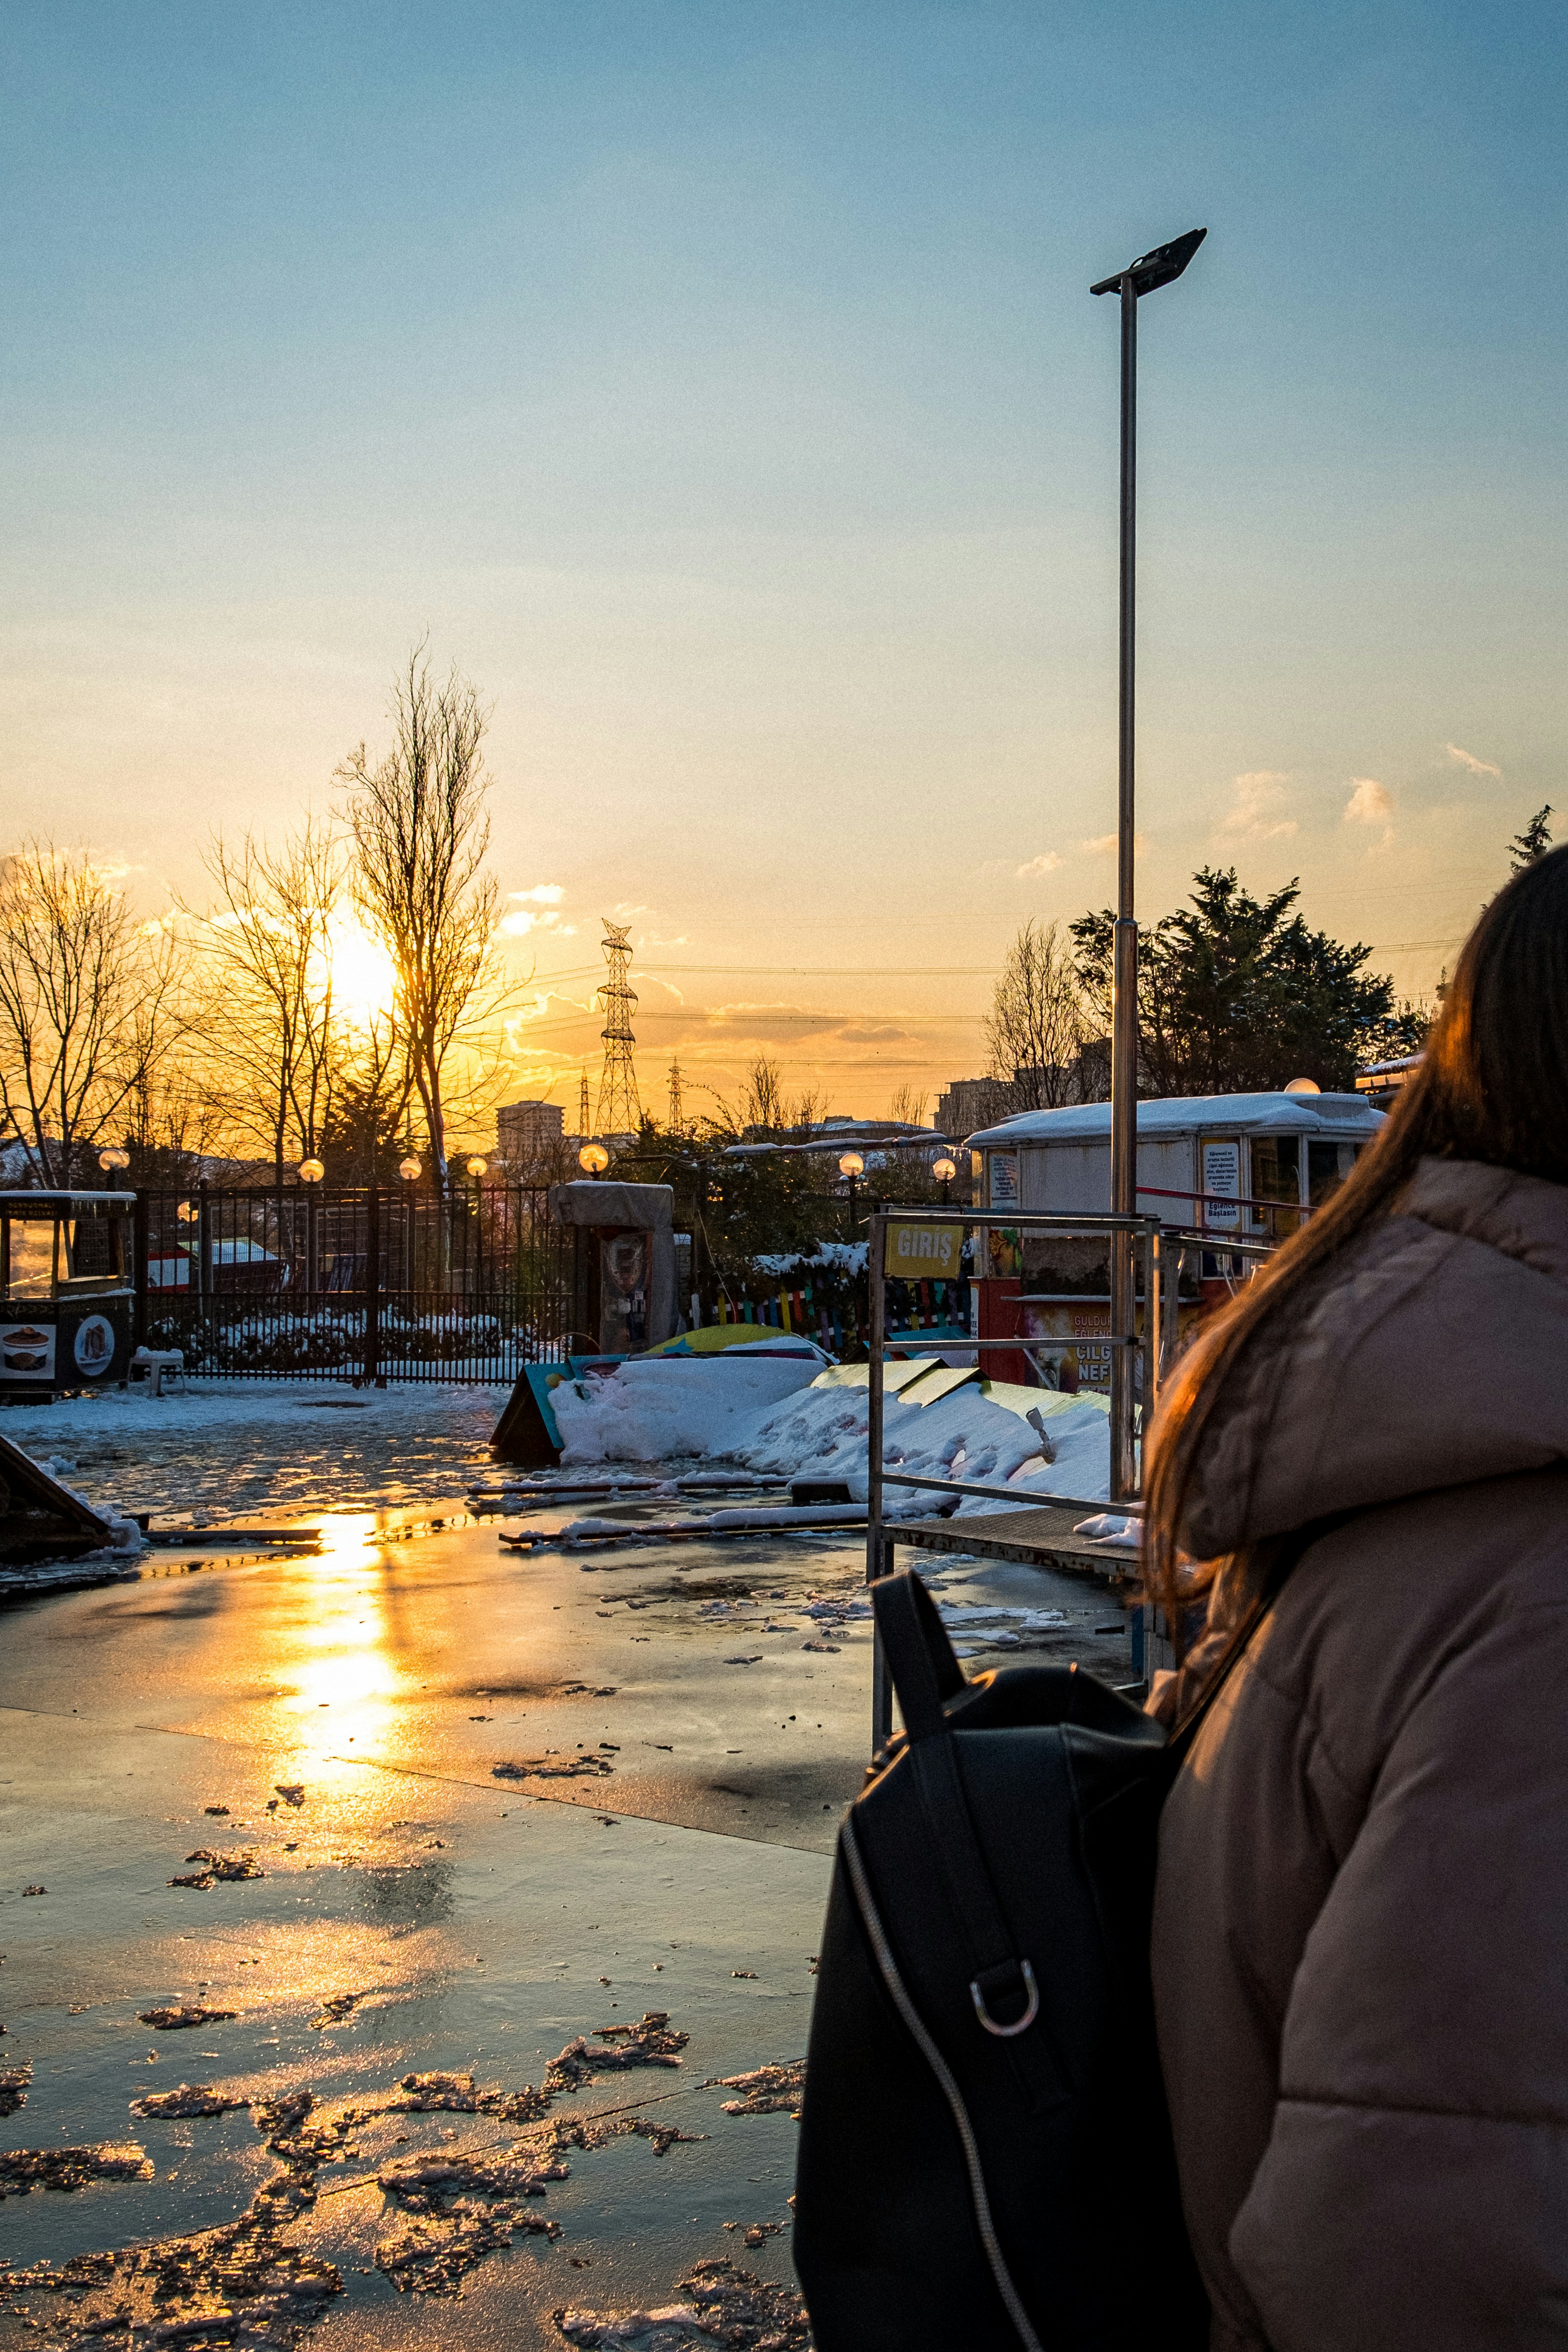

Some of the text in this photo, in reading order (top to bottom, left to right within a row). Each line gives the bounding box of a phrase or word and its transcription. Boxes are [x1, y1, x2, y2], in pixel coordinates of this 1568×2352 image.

[1208, 1209, 1237, 1219] Başlasın
[898, 1224, 953, 1267] GİRİŞ
[1075, 1314, 1111, 1326] GÜLDÜR
[1075, 1326, 1111, 1338] EĞLENC
[1076, 1346, 1111, 1363] ÇILG
[1079, 1364, 1111, 1380] NEF
